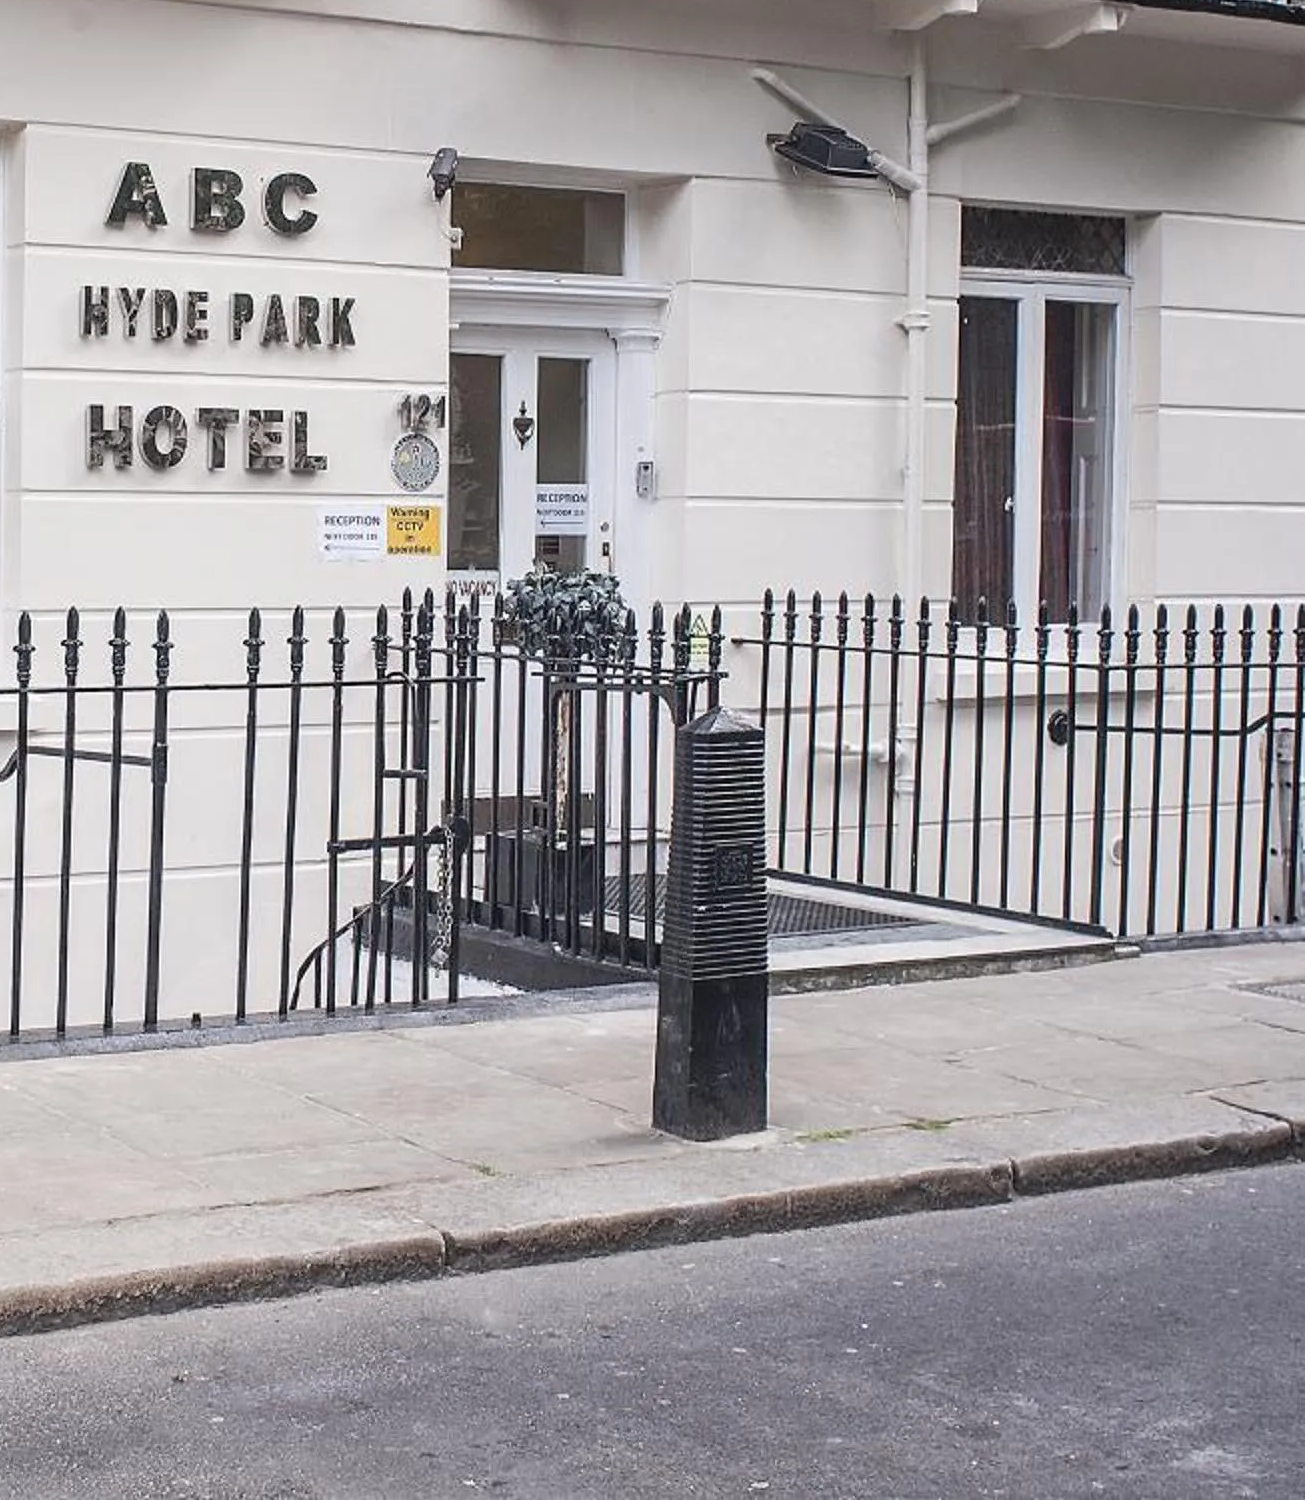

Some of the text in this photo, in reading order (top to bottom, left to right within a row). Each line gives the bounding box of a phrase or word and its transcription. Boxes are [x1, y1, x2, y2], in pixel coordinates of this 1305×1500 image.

[105, 161, 319, 235] ABC
[80, 285, 356, 347] HYDE PARK
[398, 394, 446, 431] 121
[86, 404, 328, 474] HOTEL
[324, 515, 380, 526] RECEPTION
[390, 507, 430, 520] Warning
[396, 521, 423, 531] CCTV
